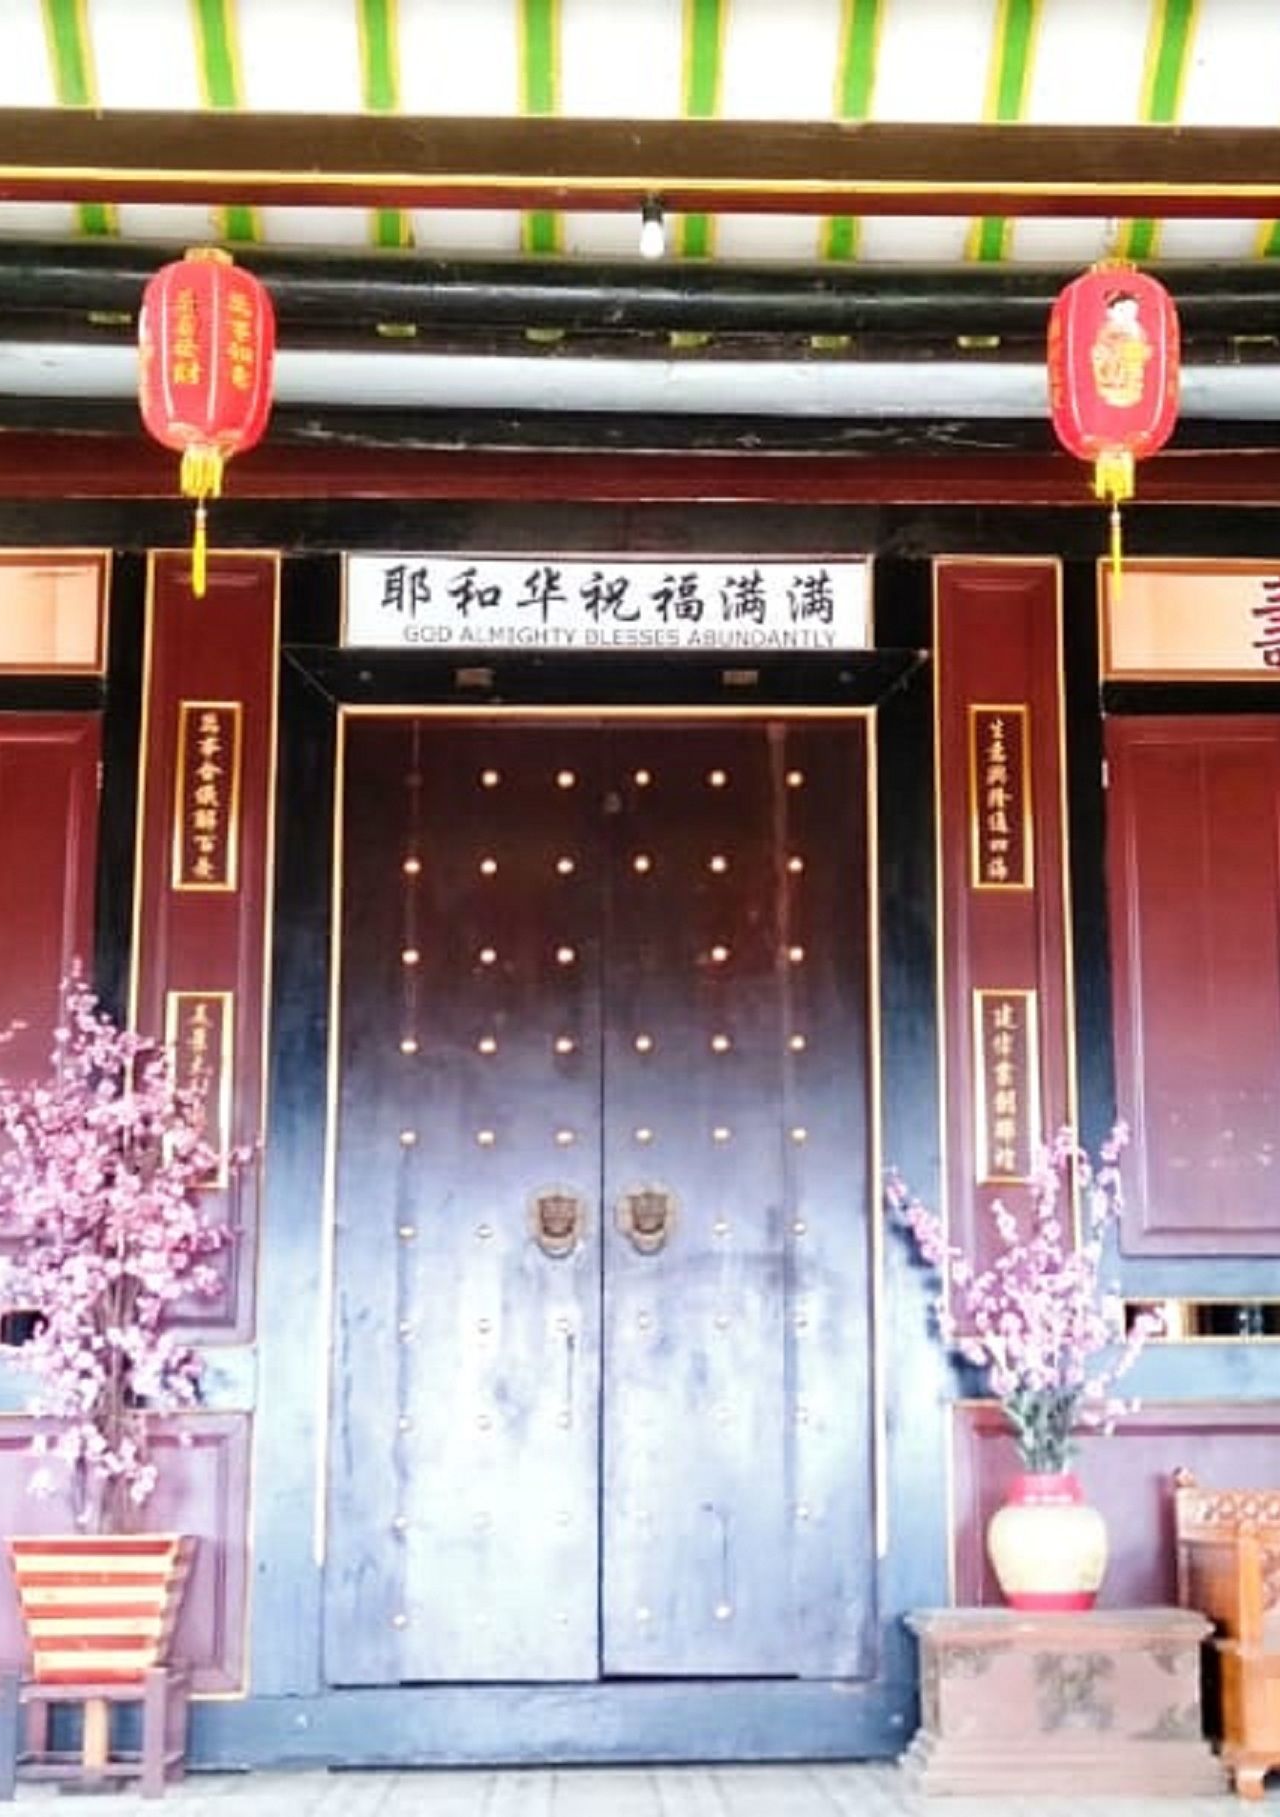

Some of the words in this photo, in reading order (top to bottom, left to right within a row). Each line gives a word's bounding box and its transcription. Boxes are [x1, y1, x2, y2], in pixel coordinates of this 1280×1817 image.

[380, 563, 836, 626] 耶和华祝福满满
[403, 624, 453, 644] GOD
[459, 626, 577, 646] ALMIGHTY
[583, 627, 680, 647] BLESSES
[686, 628, 837, 649] ABUNDANTLY
